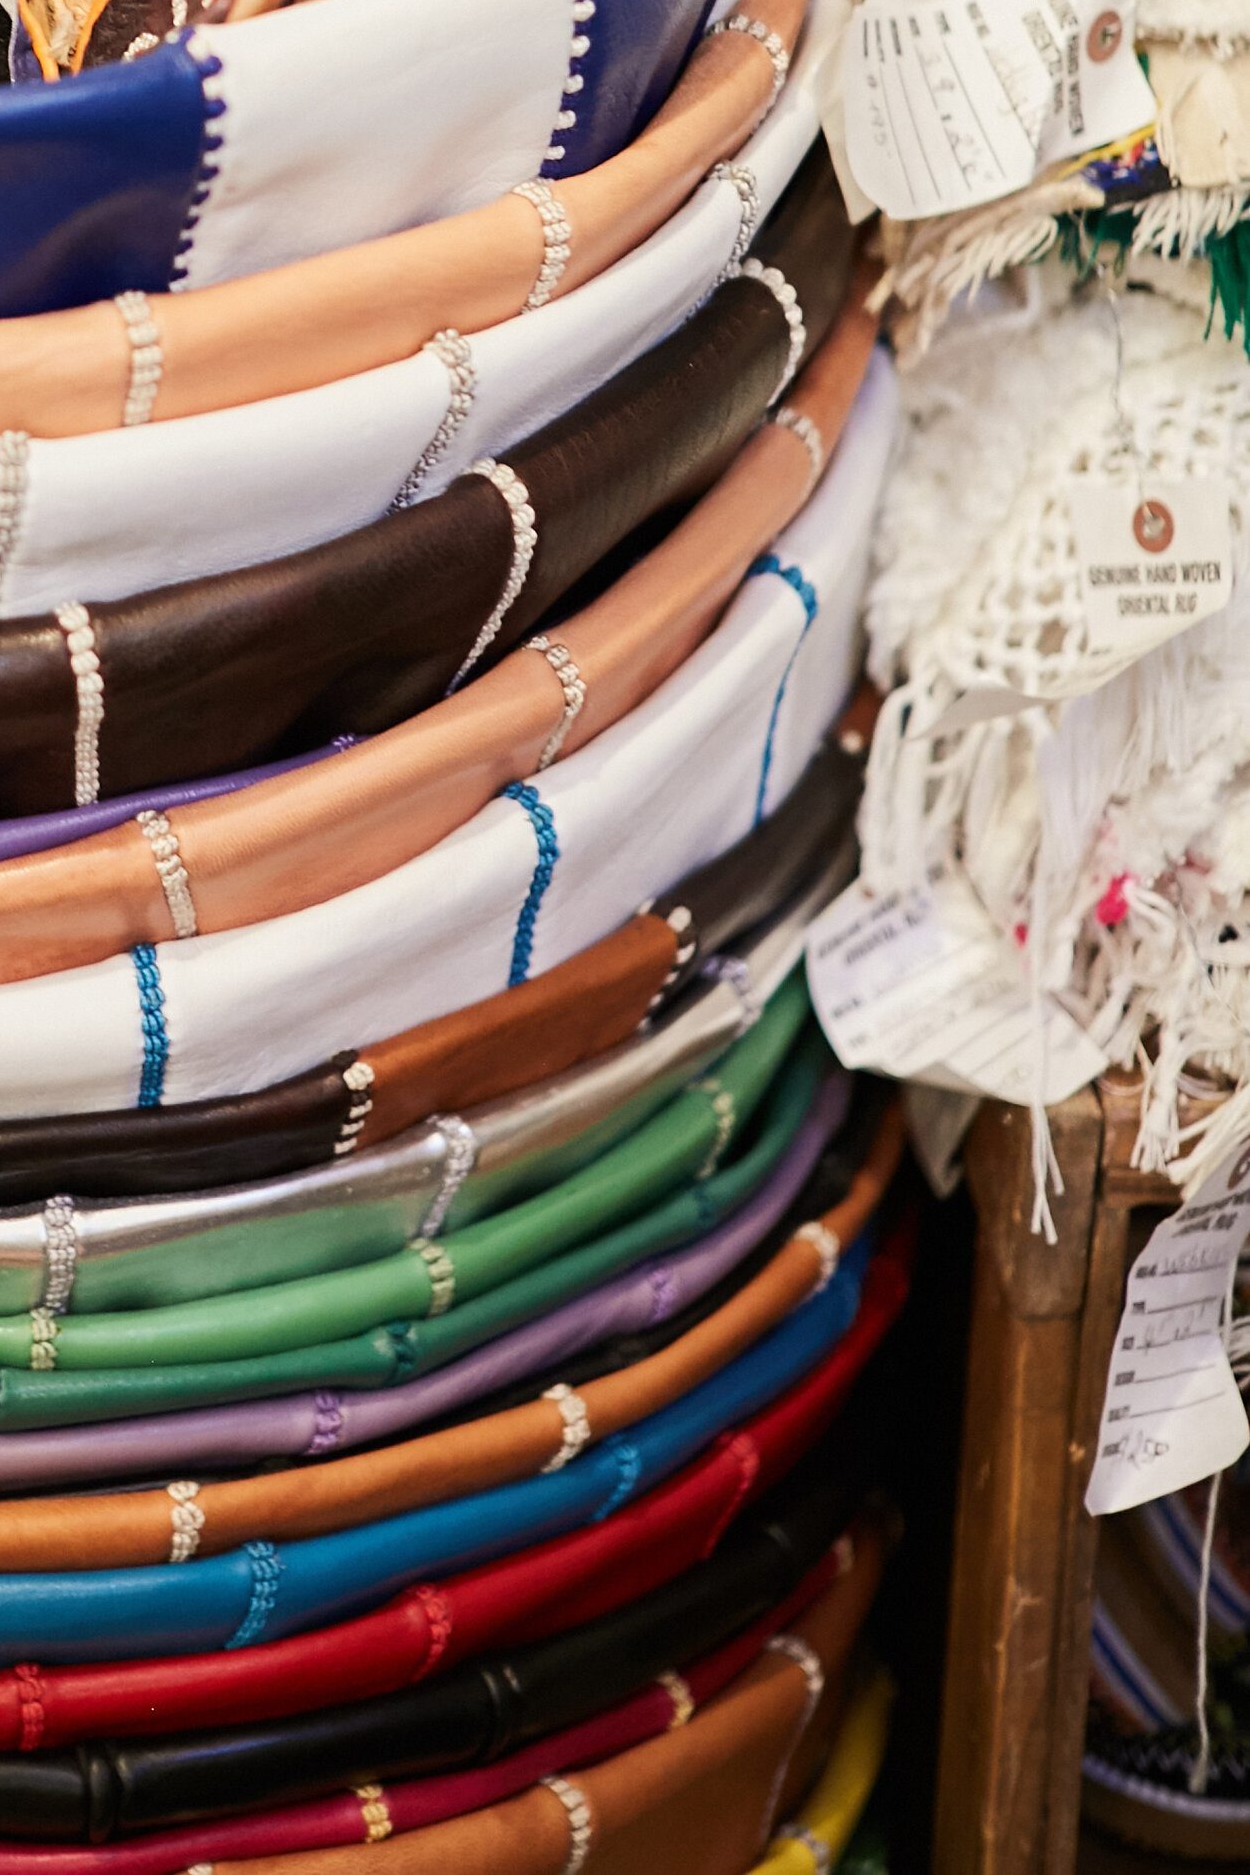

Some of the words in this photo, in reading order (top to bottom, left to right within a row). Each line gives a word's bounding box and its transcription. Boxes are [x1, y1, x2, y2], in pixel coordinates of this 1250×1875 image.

[1089, 564, 1141, 586] GENUINE
[1146, 563, 1177, 583] HAND
[1180, 561, 1221, 583] WOVEN
[1117, 595, 1170, 616] ORIENTAL
[1175, 593, 1197, 613] RUG
